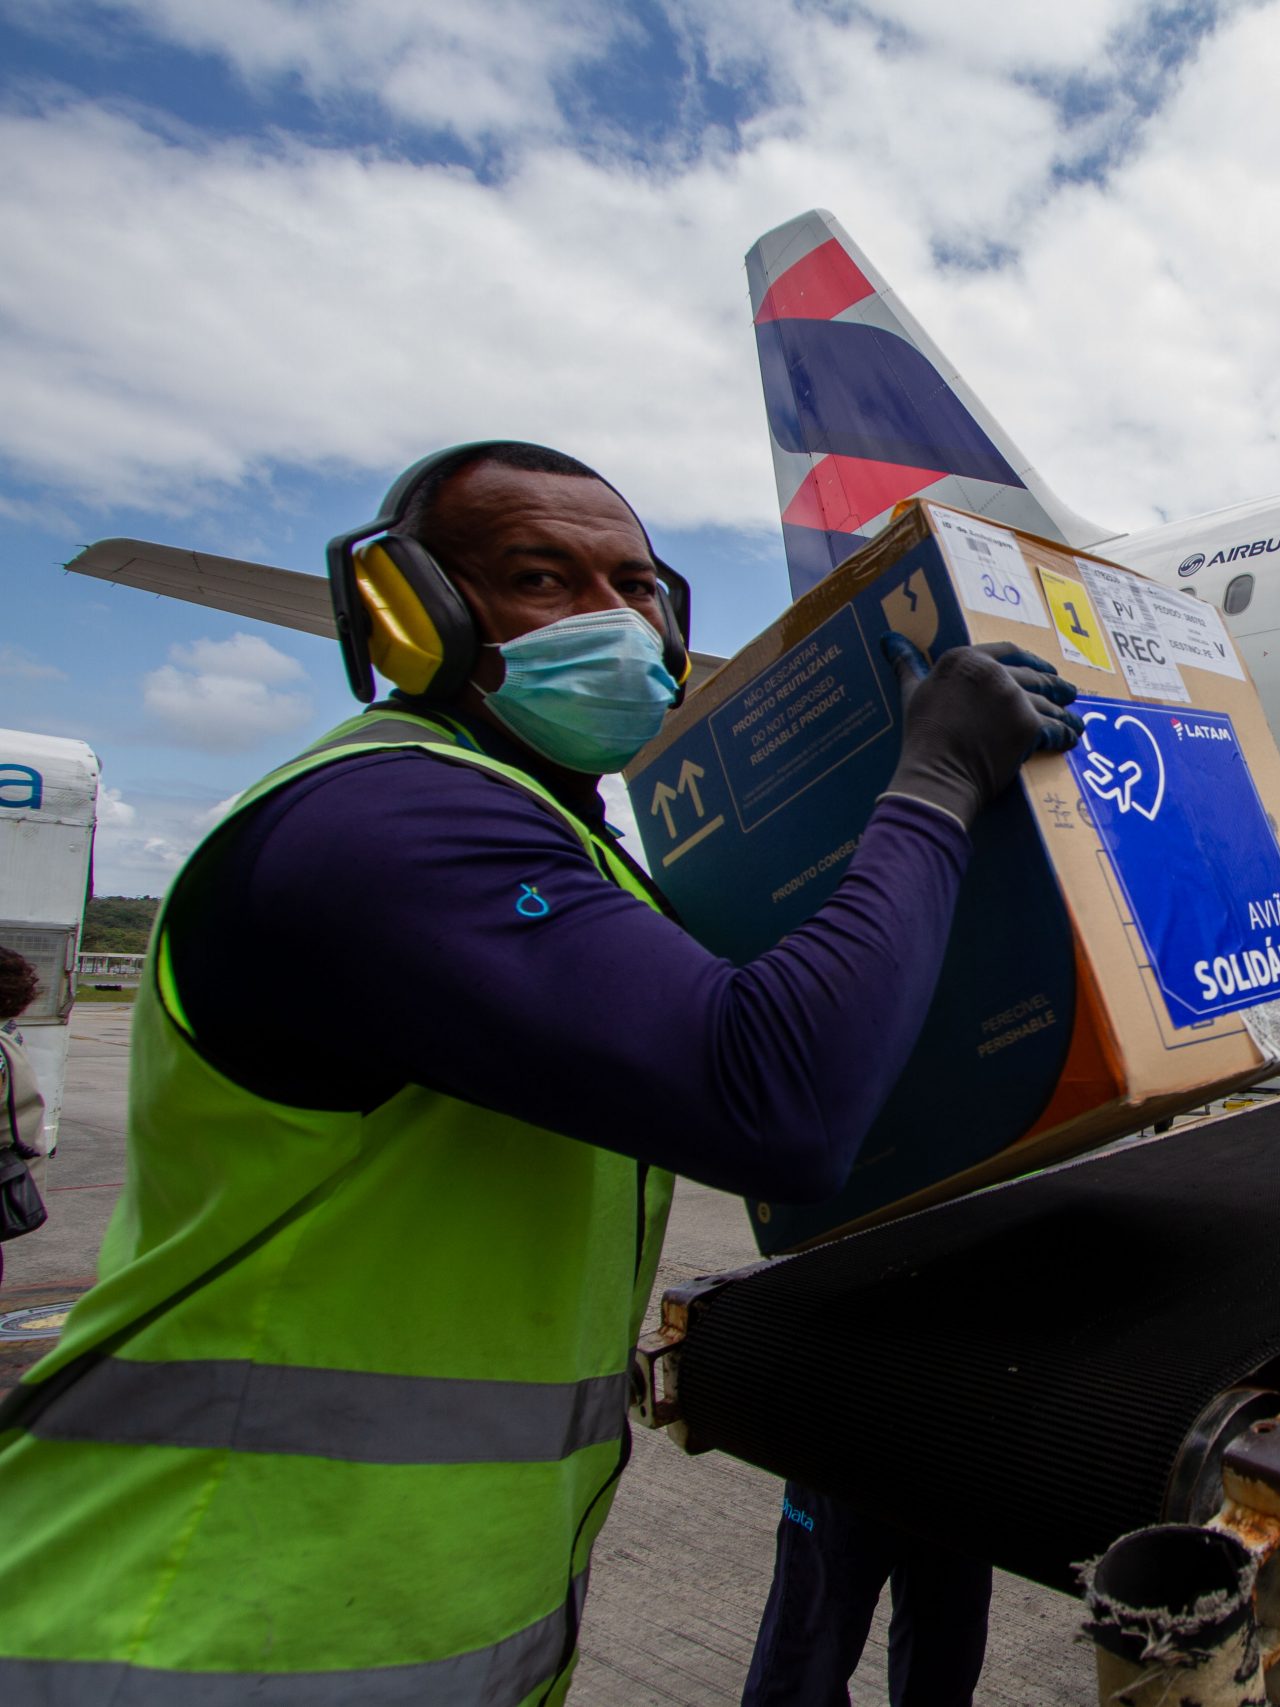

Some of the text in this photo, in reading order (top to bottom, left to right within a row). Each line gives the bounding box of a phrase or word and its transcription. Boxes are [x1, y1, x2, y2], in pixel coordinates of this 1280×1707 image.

[981, 574, 1021, 606] 20
[1063, 602, 1090, 638] 1
[1112, 600, 1134, 620] PV
[1111, 631, 1166, 665] REC
[1213, 641, 1226, 658] V
[764, 642, 820, 694] DESCARTAR
[732, 696, 777, 737] PRODUTO
[750, 722, 801, 767] REUSABLE
[799, 684, 847, 728] PRODUCT
[751, 728, 767, 748] DO
[767, 714, 787, 736] NOT
[786, 675, 836, 720] DISPOSED
[1186, 722, 1232, 742] LATAM
[772, 866, 817, 903] PRODUTO
